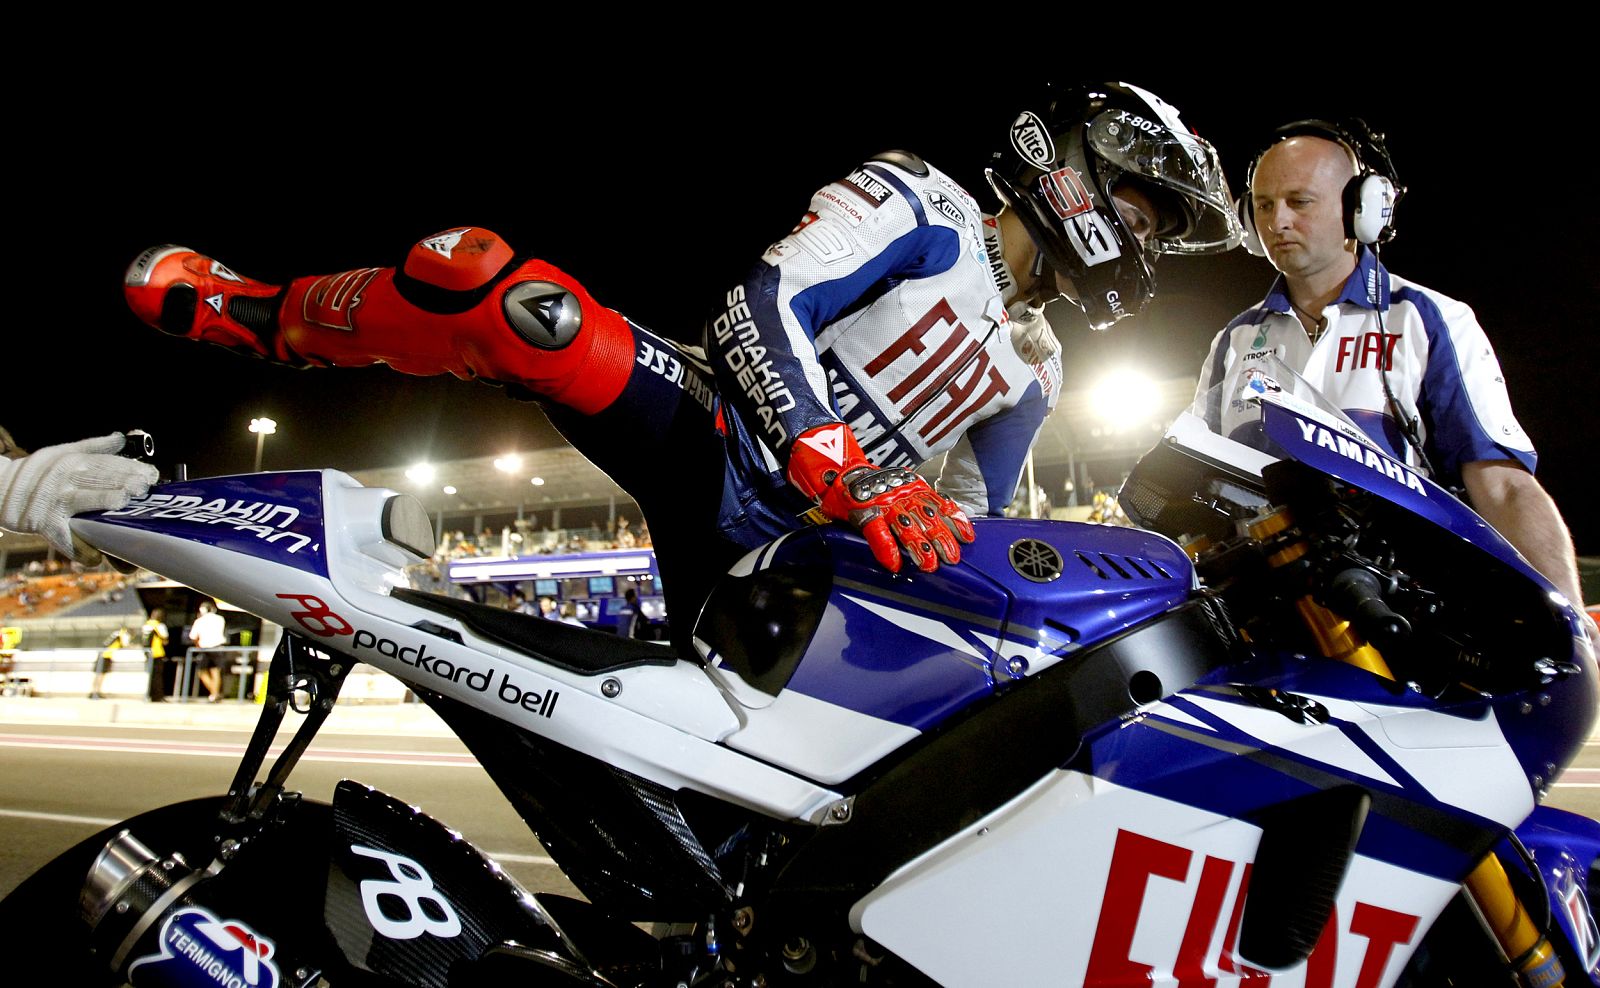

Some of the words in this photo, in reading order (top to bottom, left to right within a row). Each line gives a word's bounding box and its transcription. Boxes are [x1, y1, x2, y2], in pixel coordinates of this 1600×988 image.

[984, 235, 1011, 292] YAMAHA
[713, 312, 734, 345] DI
[725, 345, 788, 449] DEPAN
[727, 284, 795, 413] SEMAKIN
[863, 297, 1010, 447] FIAT
[1335, 332, 1402, 373] FIAT
[1295, 418, 1428, 496] YAMAHA
[150, 507, 311, 553] DEPAN
[353, 629, 494, 692] packard
[498, 674, 559, 718] bell
